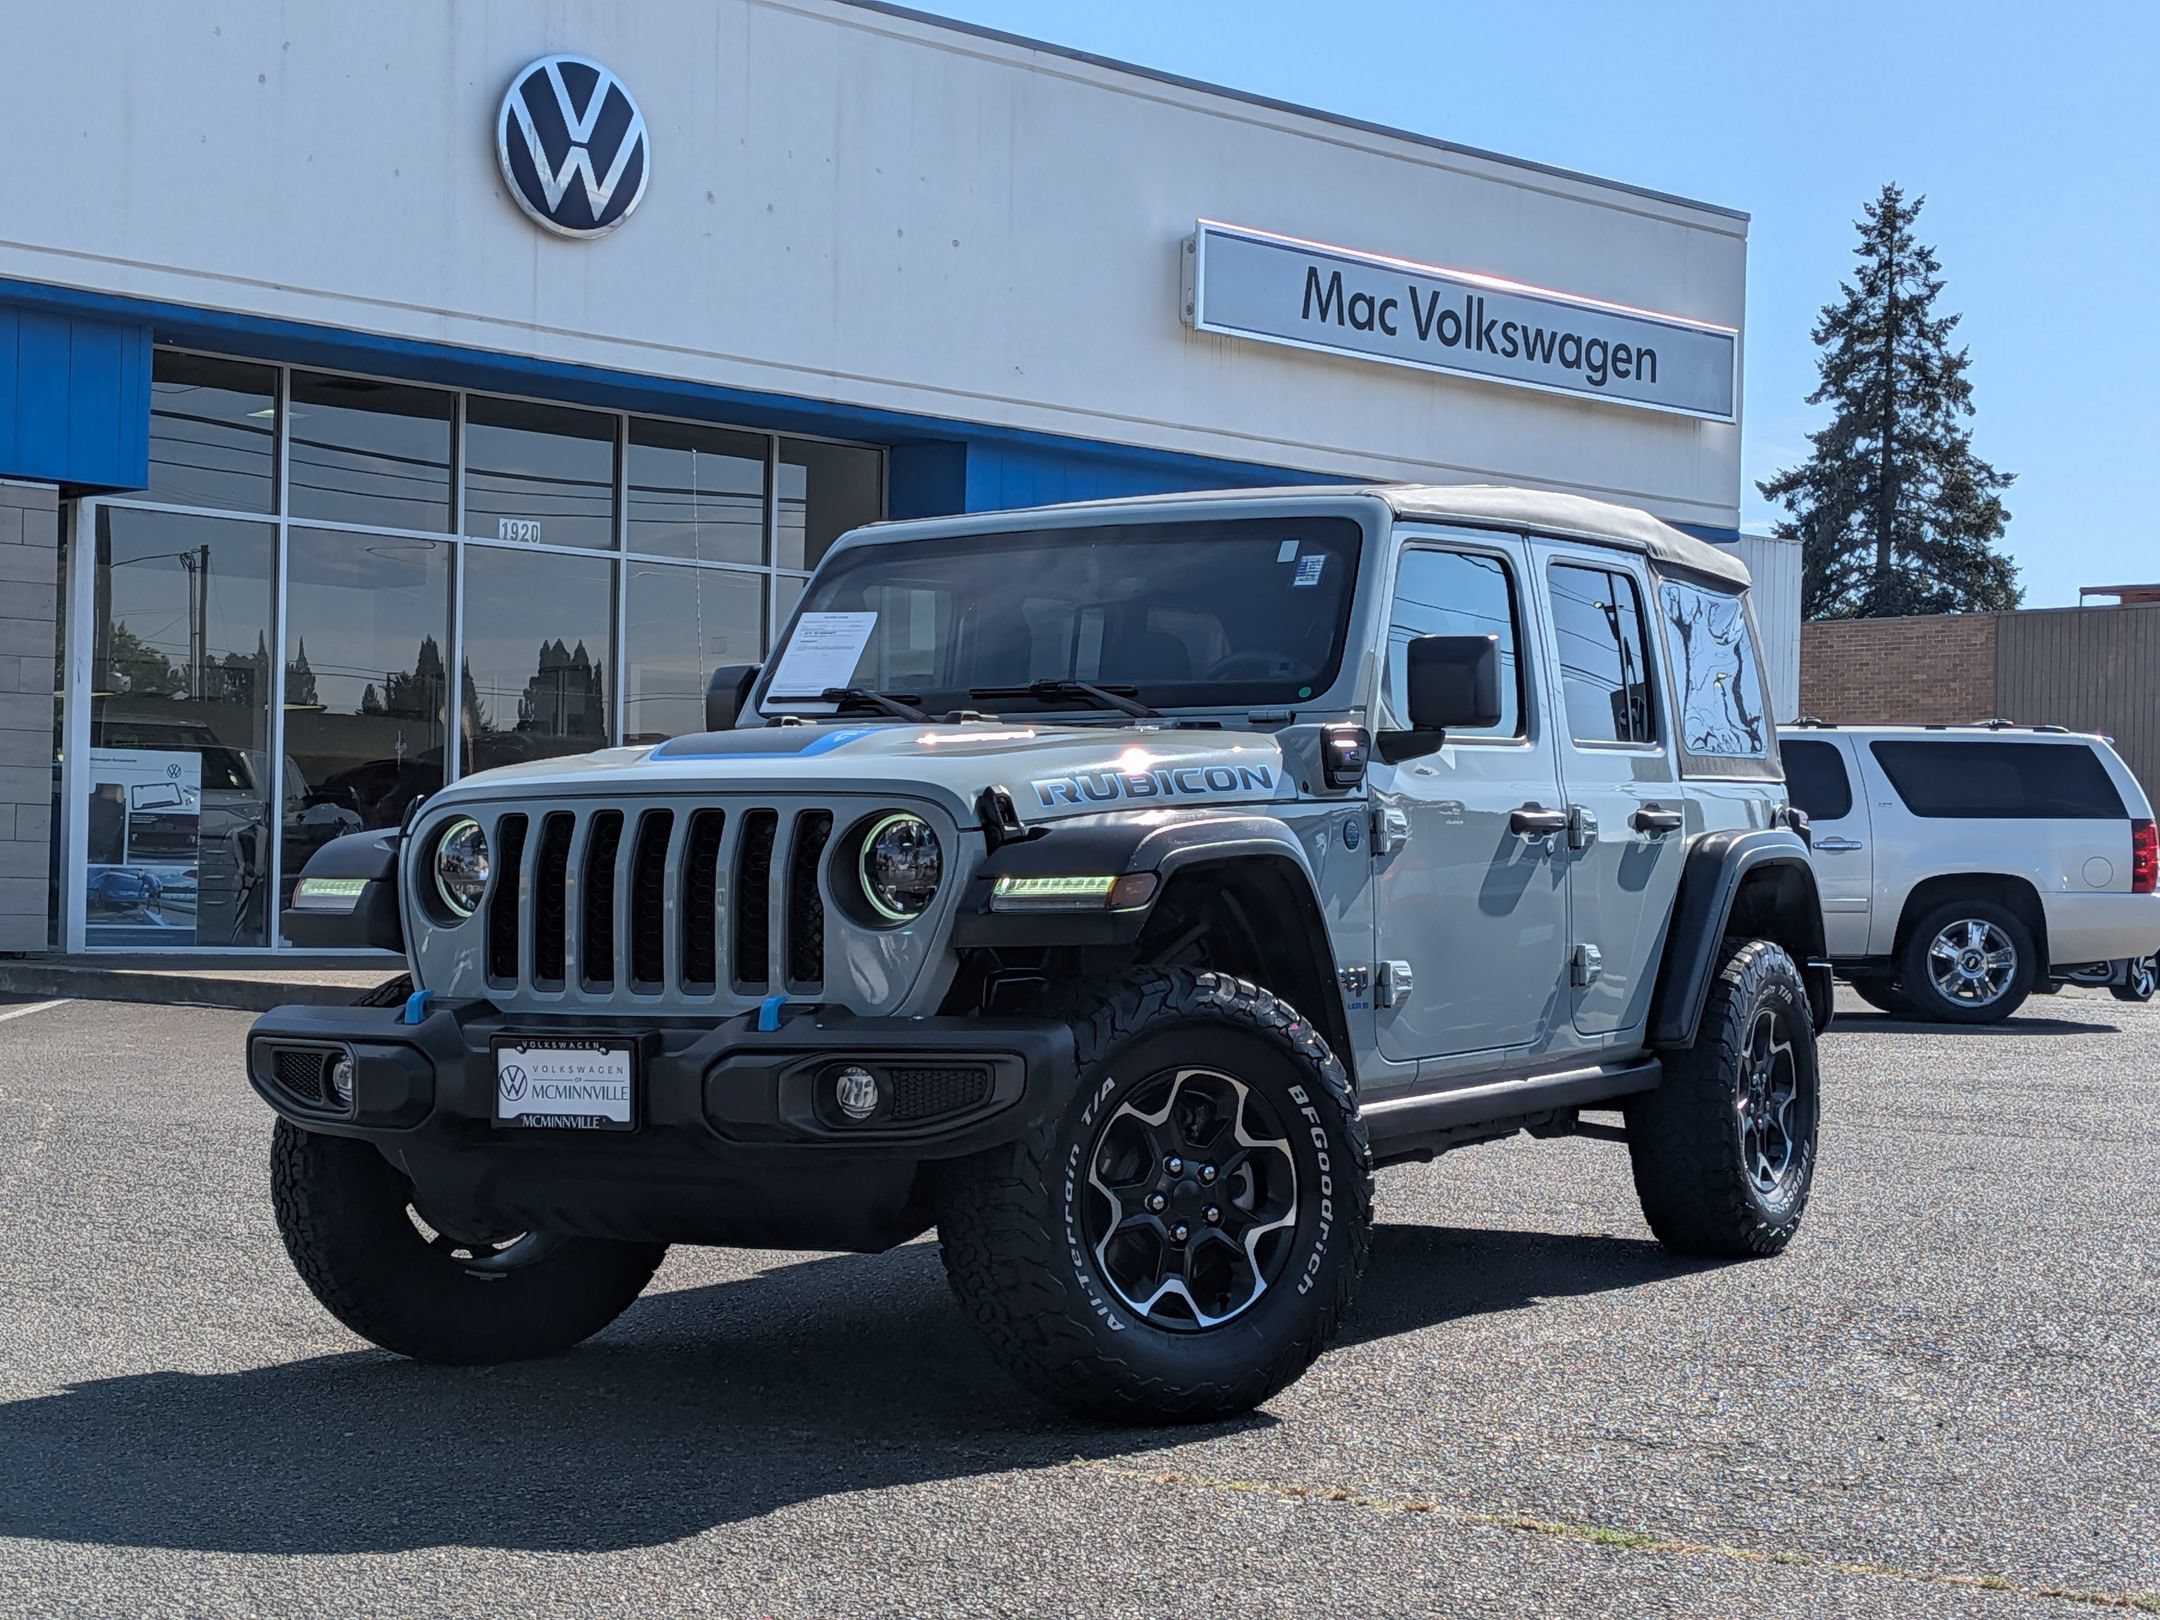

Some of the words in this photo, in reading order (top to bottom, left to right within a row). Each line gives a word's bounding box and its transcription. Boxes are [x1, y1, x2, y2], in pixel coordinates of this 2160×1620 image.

[1301, 265, 1398, 337] Mac
[1407, 285, 1658, 388] Volkswagen
[501, 521, 539, 543] 1920
[1030, 764, 1274, 808] RUBICON
[521, 1040, 601, 1050] VOLKSWAGEN
[532, 1065, 624, 1075] VOLKSWAGEN
[531, 1084, 629, 1101] MCMINNVILLE
[1081, 1076, 1116, 1126] T/A
[521, 1115, 600, 1129] MCMINNVILLE
[1287, 1084, 1334, 1295] BFGoodrich
